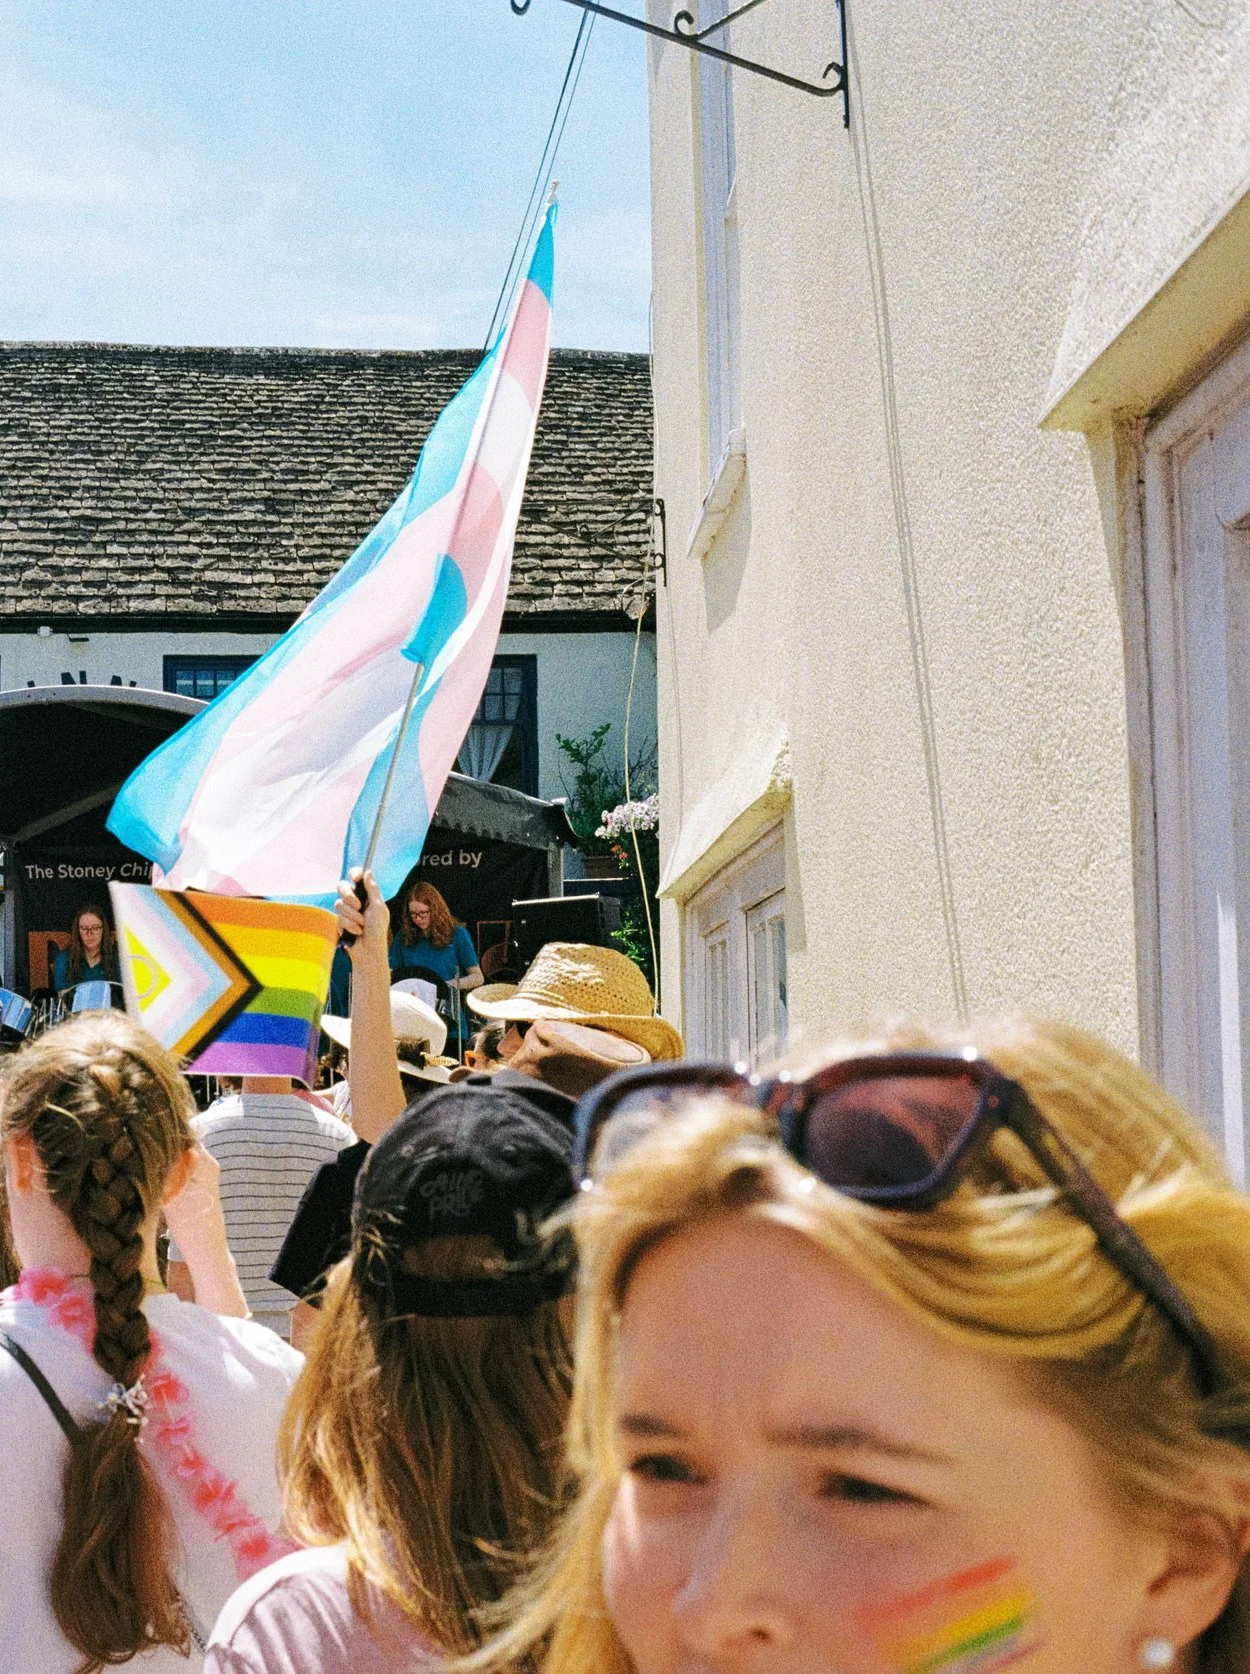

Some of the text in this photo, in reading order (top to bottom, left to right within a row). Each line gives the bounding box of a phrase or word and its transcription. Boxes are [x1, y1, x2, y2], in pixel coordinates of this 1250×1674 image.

[459, 849, 483, 869] by
[25, 864, 54, 879] The
[57, 863, 116, 881] Stoney
